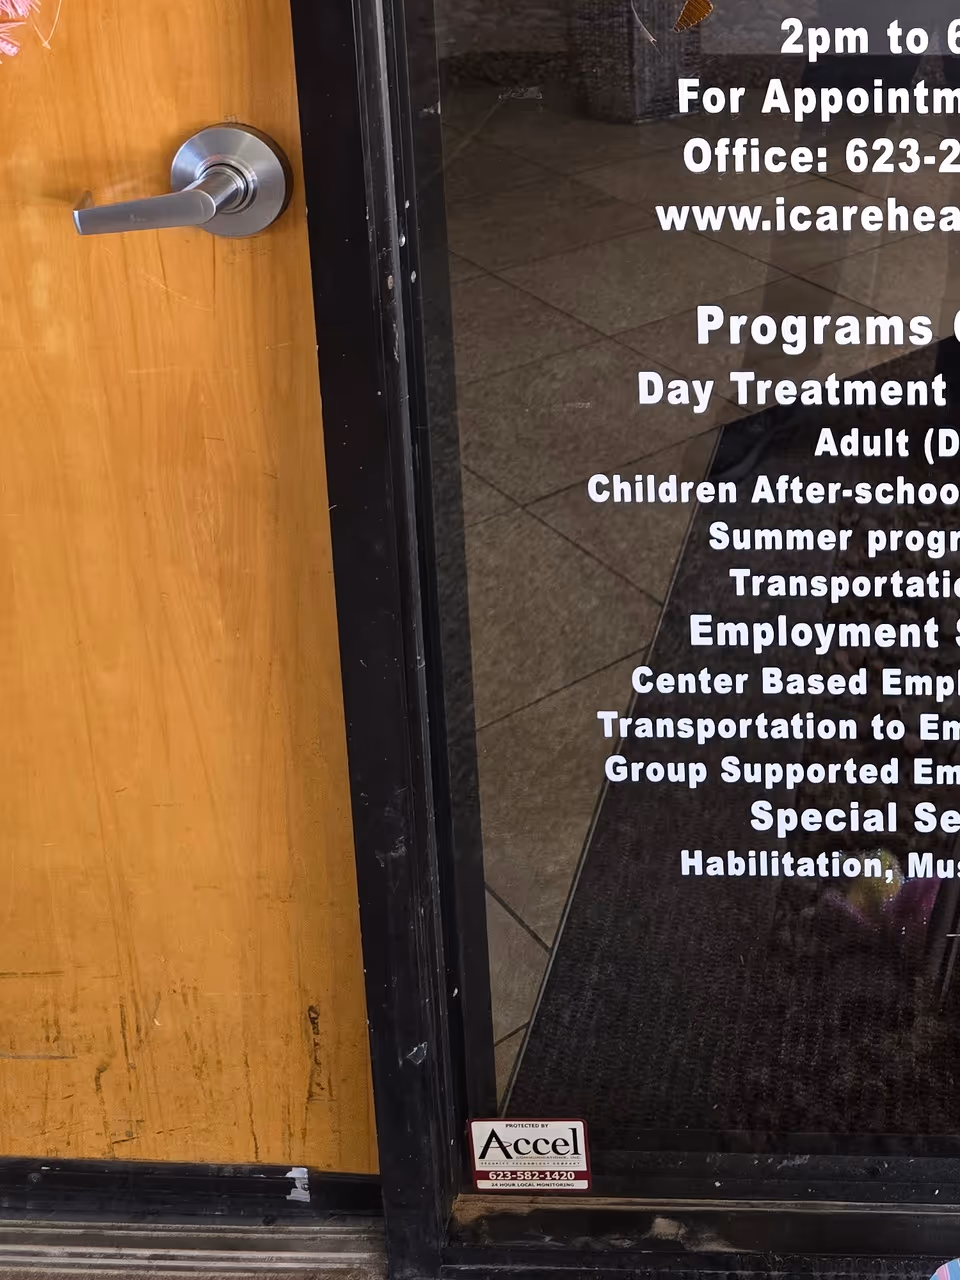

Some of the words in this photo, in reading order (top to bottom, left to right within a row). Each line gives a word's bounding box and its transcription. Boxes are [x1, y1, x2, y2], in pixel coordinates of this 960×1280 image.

[780, 17, 869, 63] 2pm
[886, 19, 929, 55] to
[678, 78, 746, 114] For
[683, 137, 827, 173] Office:
[697, 305, 933, 355] Programs
[638, 371, 714, 414] Day
[729, 371, 947, 406] Treatment
[814, 427, 909, 457] Adult
[587, 473, 737, 503] Children
[709, 521, 853, 551] Summer
[690, 614, 939, 655] Employment
[631, 665, 749, 694] Center
[762, 667, 867, 695] Based
[596, 710, 857, 745] Transportation
[871, 713, 905, 740] to
[604, 754, 707, 789] Group
[720, 755, 899, 790] Supported
[750, 800, 897, 839] Special
[680, 849, 894, 884] Habilitation,
[478, 1127, 582, 1160] Accel
[488, 1171, 576, 1181] 623-582-1420
